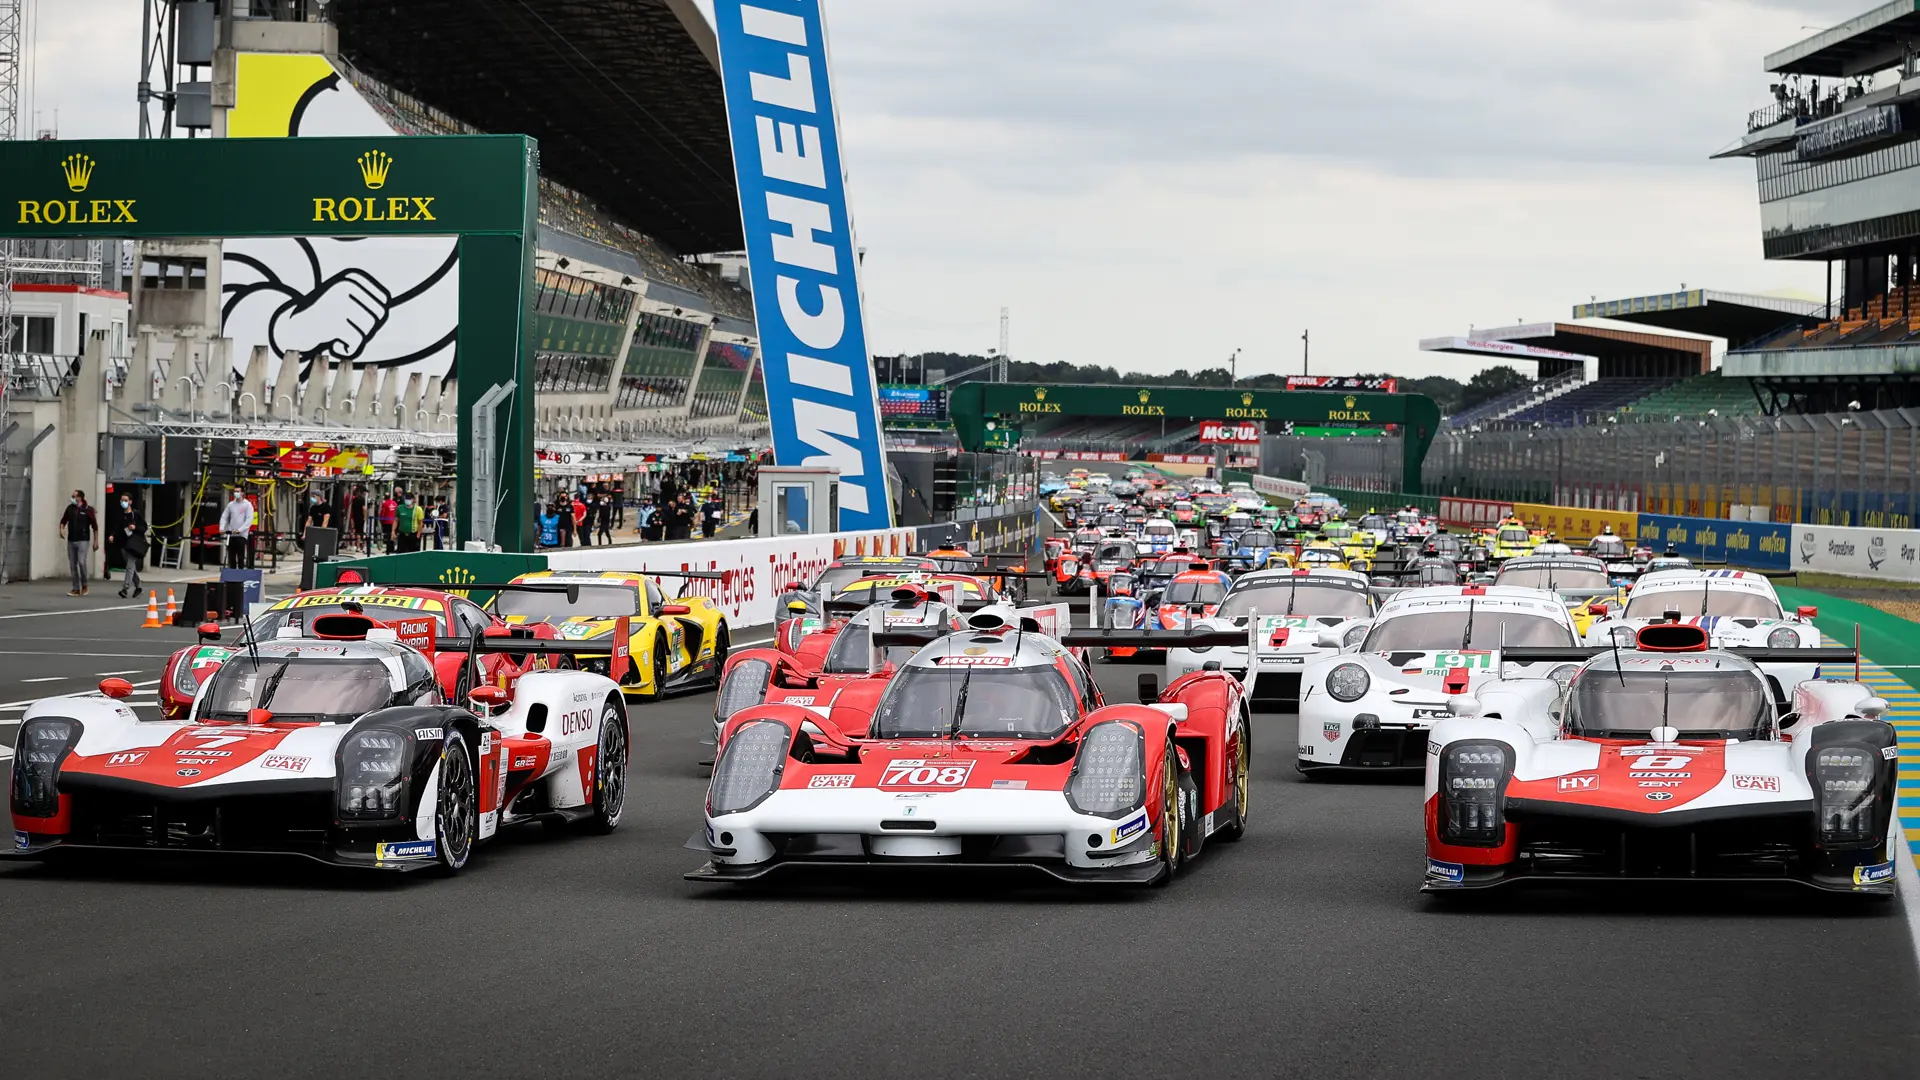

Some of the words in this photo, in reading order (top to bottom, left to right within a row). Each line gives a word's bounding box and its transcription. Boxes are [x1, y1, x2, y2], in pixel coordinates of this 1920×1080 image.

[17, 200, 138, 224] ROLEX
[312, 197, 437, 222] ROLEX
[1288, 377, 1319, 386] MOTUL
[1020, 402, 1061, 413] ROLEX
[1122, 405, 1165, 416] ROLEX
[1226, 407, 1268, 418] ROLEX
[1328, 410, 1371, 421] ROLEX
[1202, 426, 1259, 441] MOTUL
[1504, 561, 1602, 571] PORSCHE
[1252, 578, 1347, 586] PORSCHE
[1642, 579, 1765, 590] PORSCHE
[1408, 599, 1535, 608] PORSCHE
[400, 621, 429, 635] RACING
[1270, 618, 1305, 629] 92
[560, 625, 586, 636] 63
[941, 657, 1009, 666] MOTUL
[1444, 653, 1481, 669] 91
[1624, 656, 1710, 665] DENSO
[1426, 669, 1448, 677] PRO
[562, 708, 593, 736] DENSO
[1326, 723, 1340, 731] TAG
[419, 728, 441, 740] AISIN
[1324, 731, 1341, 740] HEUER
[195, 735, 248, 749] 7
[109, 754, 141, 764] HY
[266, 755, 309, 763] HYPER
[514, 759, 525, 767] GR
[1629, 755, 1693, 770] 8
[265, 760, 305, 771] CAR
[886, 767, 966, 785] 708
[1734, 775, 1777, 783] HYPER
[811, 779, 851, 787] CAR
[1559, 776, 1593, 790] HY
[1637, 780, 1682, 788] ZENT
[1735, 781, 1777, 791] CAR
[396, 844, 433, 857] MICHELIN
